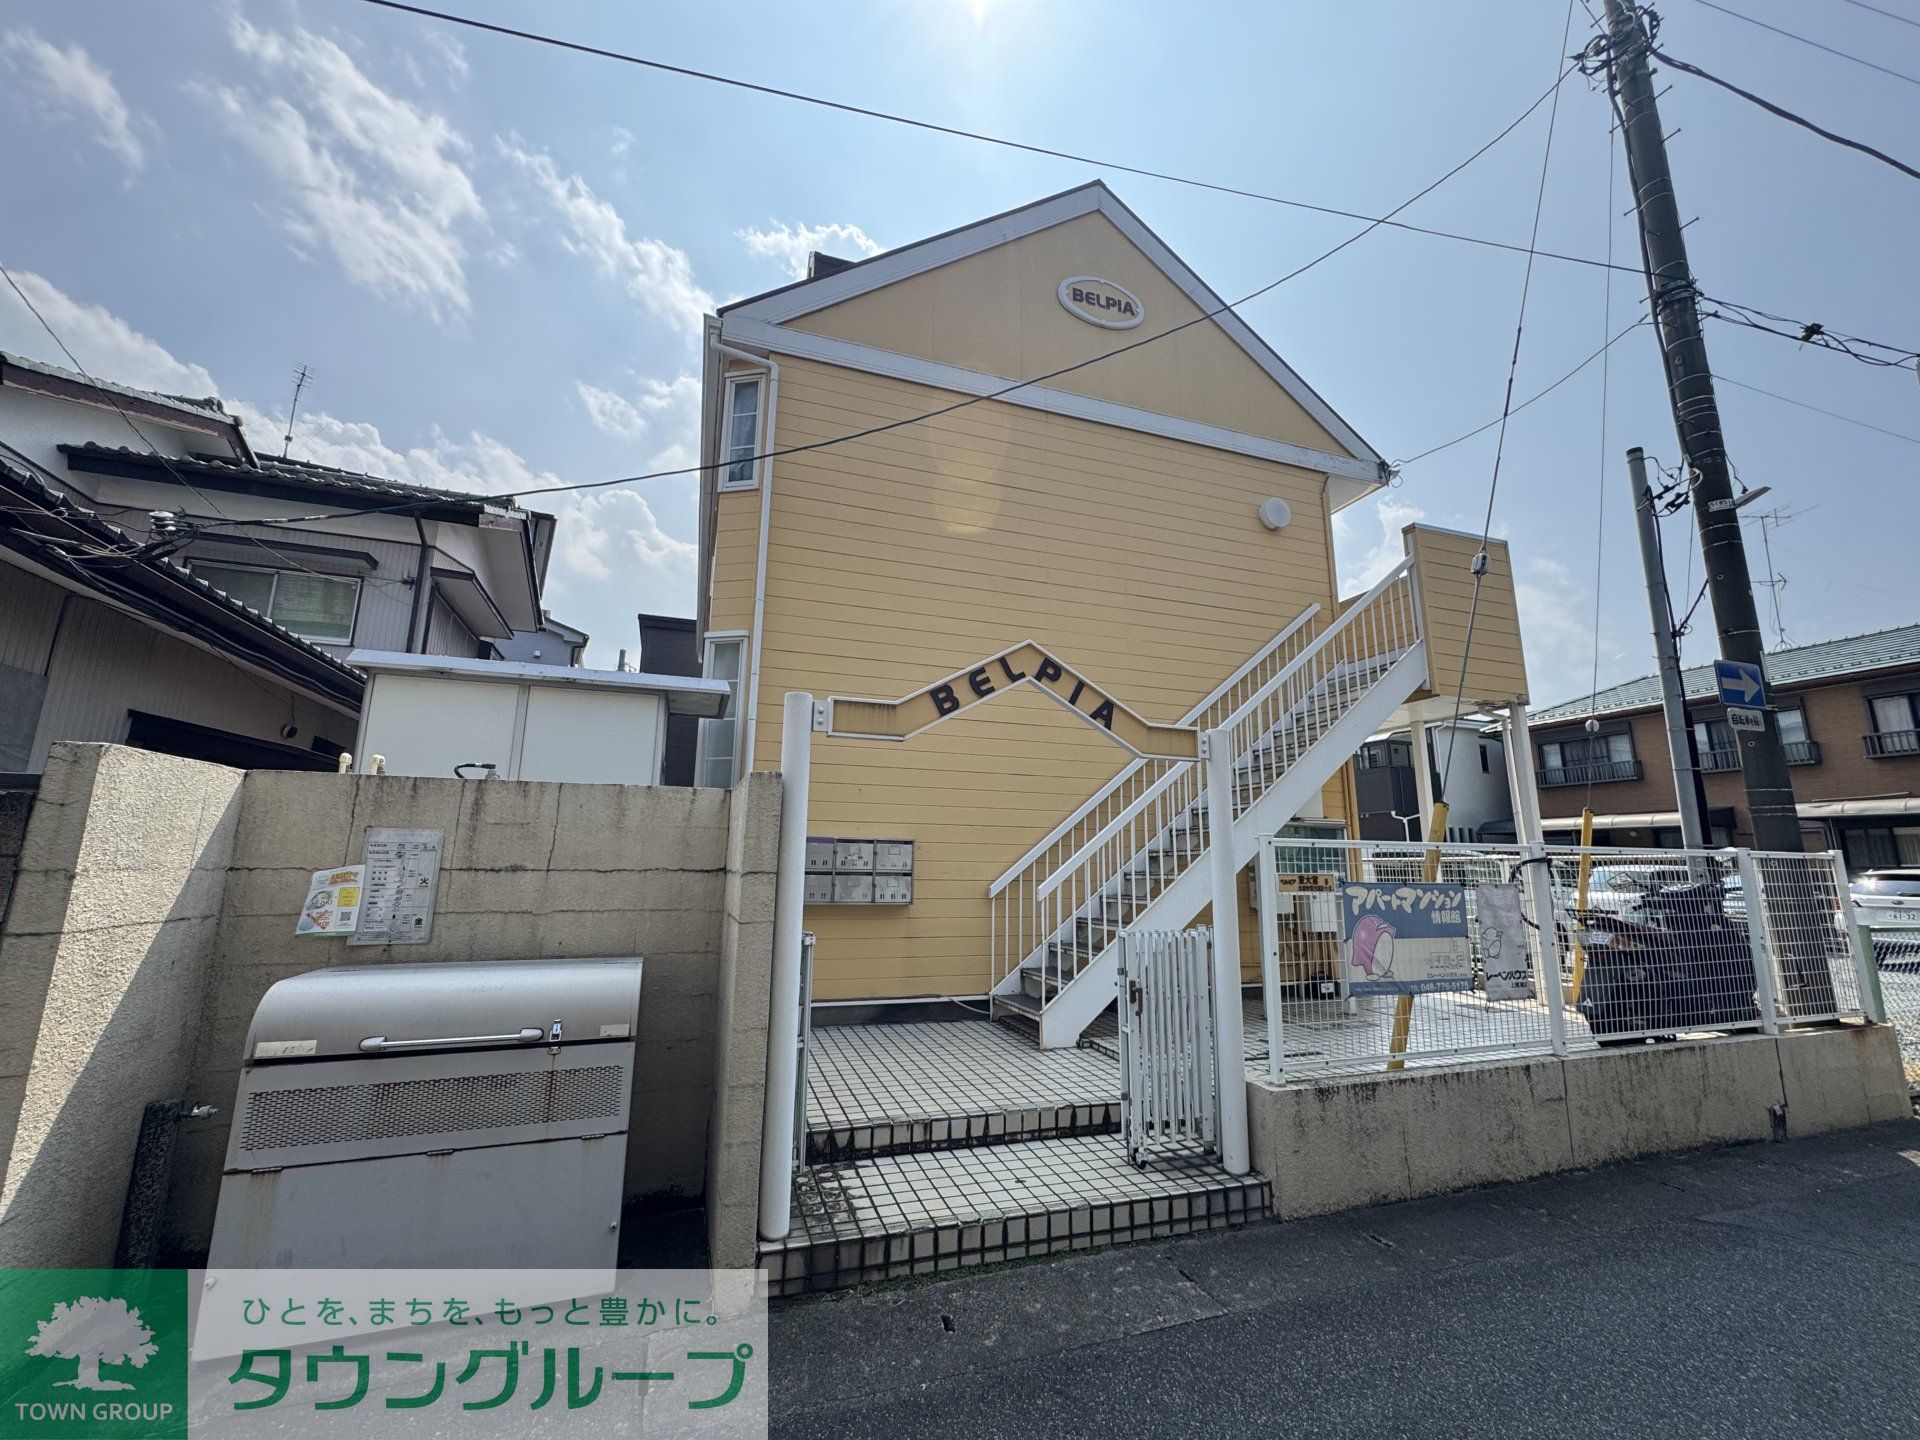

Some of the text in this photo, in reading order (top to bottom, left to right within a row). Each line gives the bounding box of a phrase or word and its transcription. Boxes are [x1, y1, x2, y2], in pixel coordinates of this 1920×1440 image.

[1072, 287, 1135, 317] BELPIA
[929, 657, 1117, 731] BELPIA
[419, 877, 429, 885] 火
[1345, 886, 1462, 916] アパートマンション
[1431, 910, 1461, 925] 情報館
